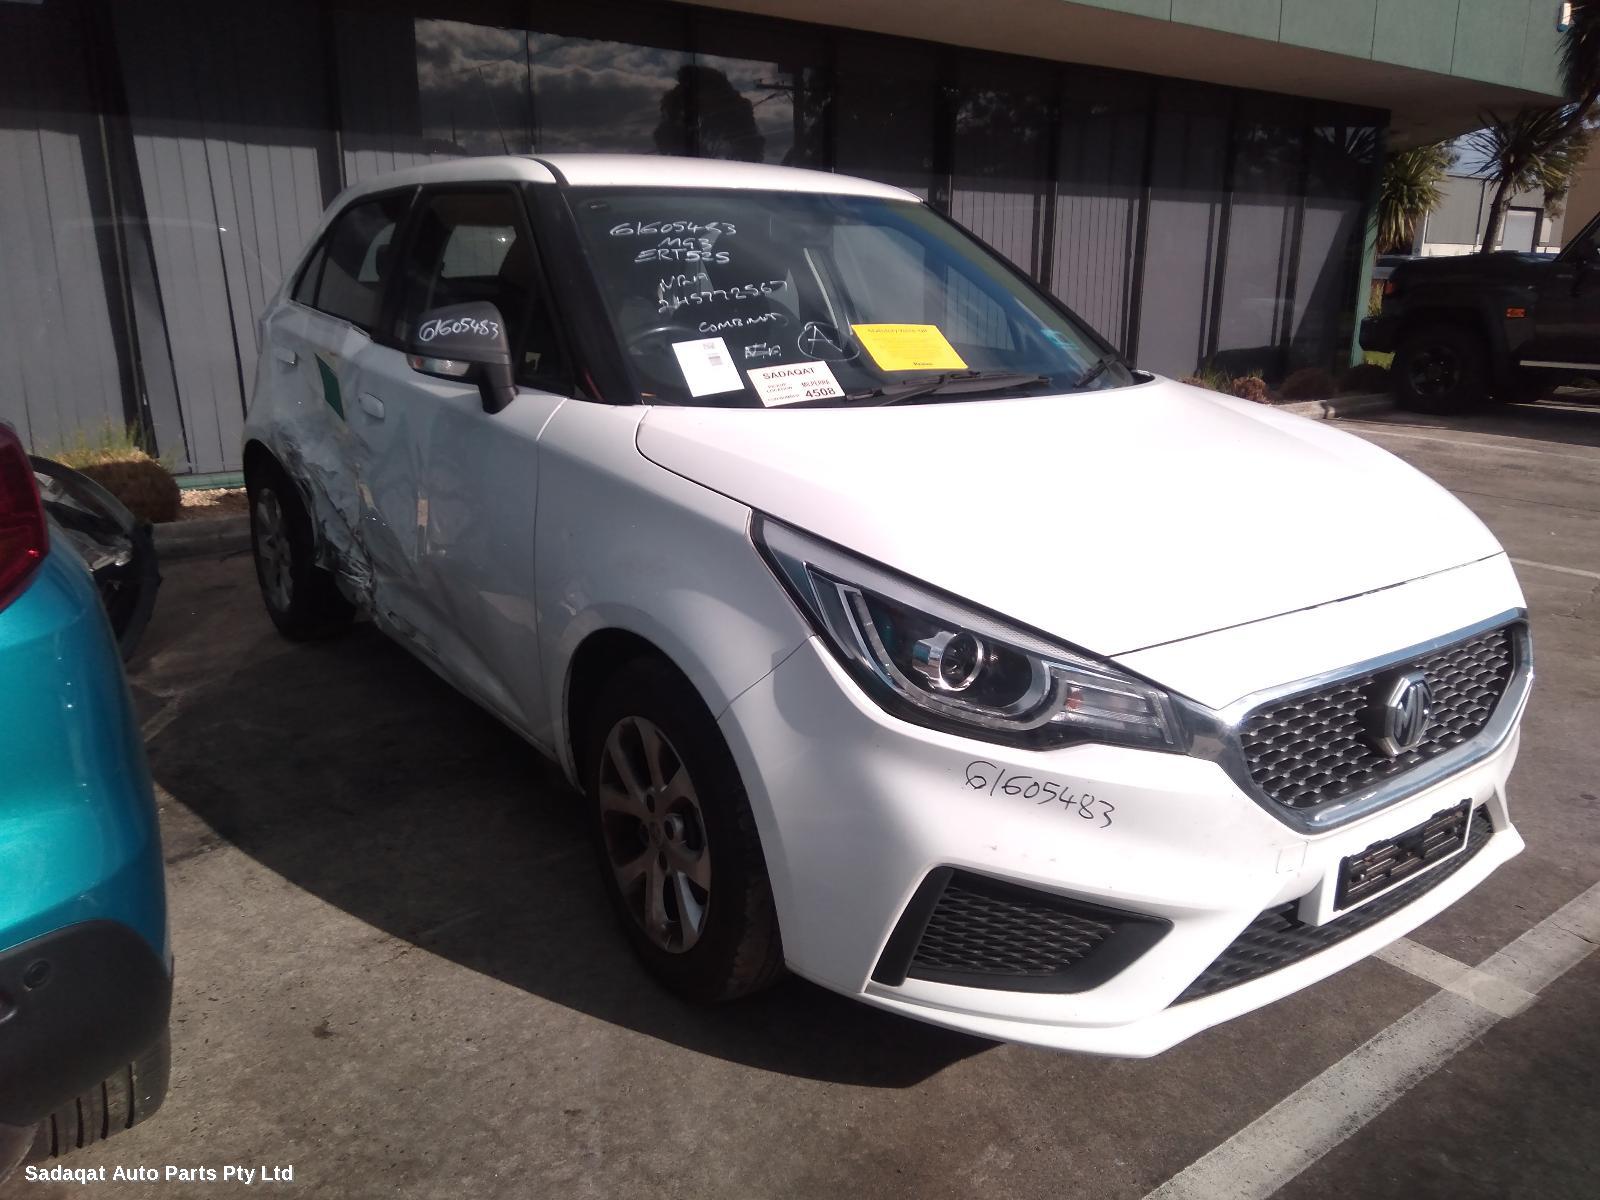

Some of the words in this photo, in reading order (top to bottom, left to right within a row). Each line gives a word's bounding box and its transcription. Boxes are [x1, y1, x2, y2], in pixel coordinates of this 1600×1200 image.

[418, 317, 499, 341] 61605483
[762, 367, 816, 380] SADAQAT
[805, 387, 836, 398] 4508
[965, 760, 1115, 829] 61605483
